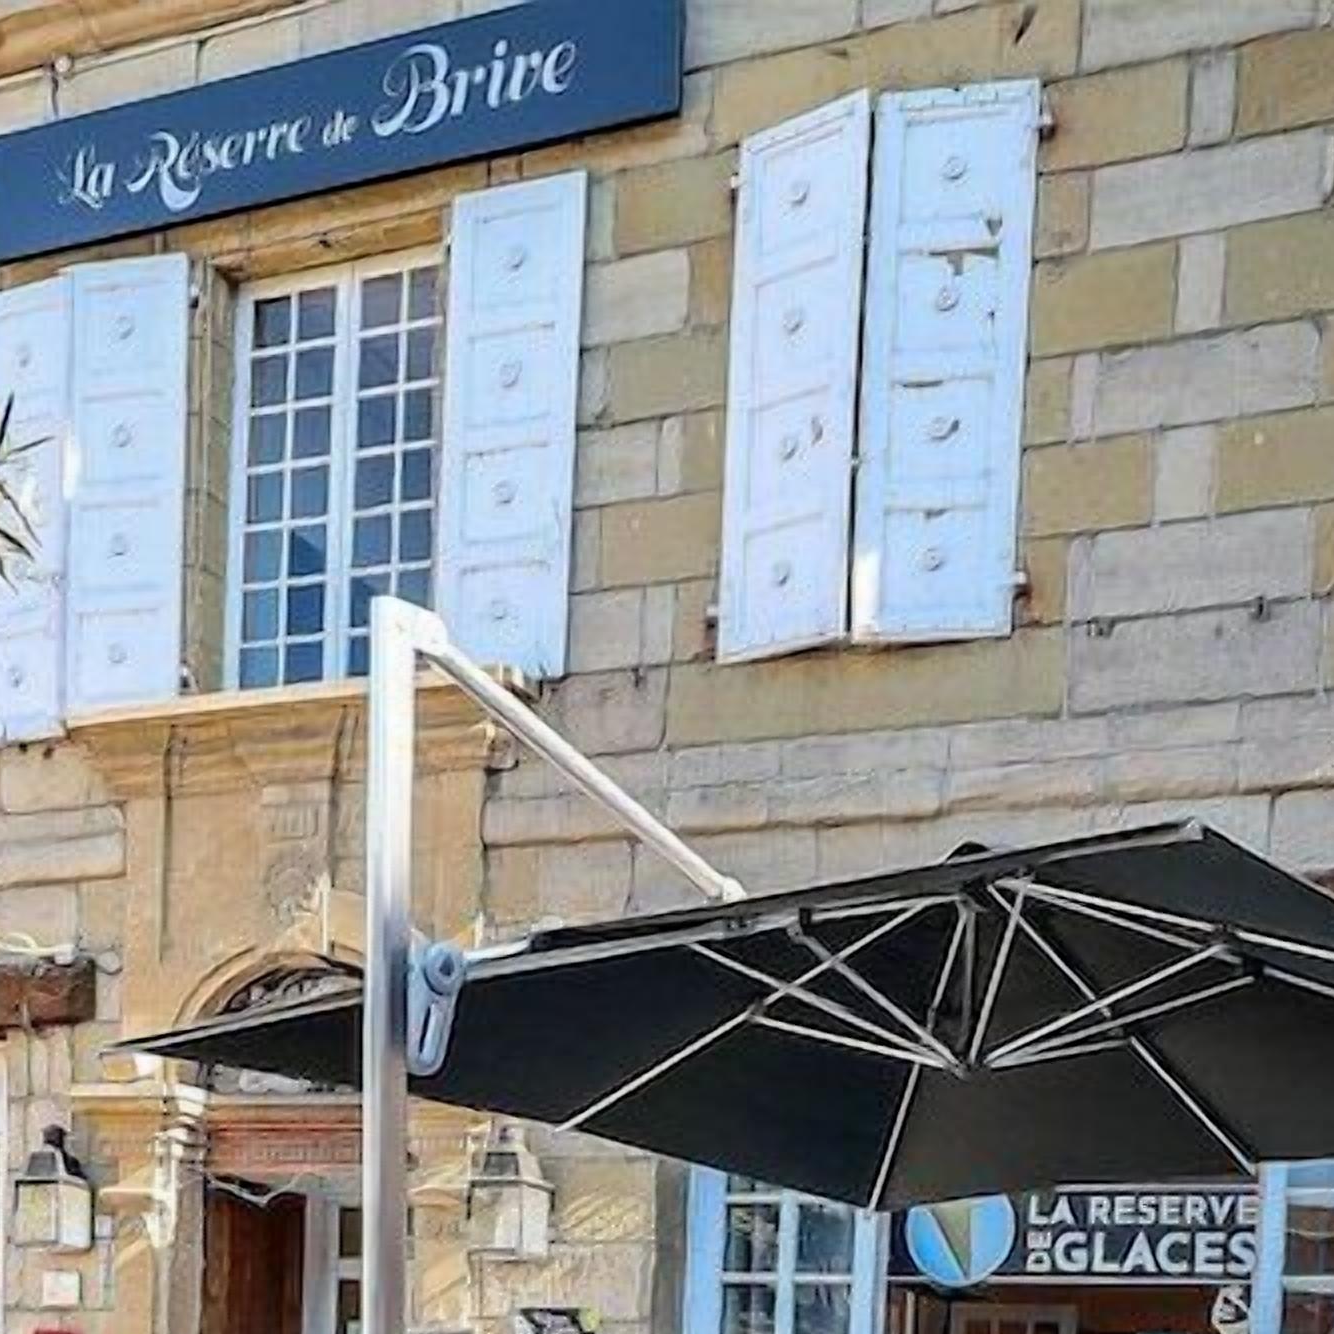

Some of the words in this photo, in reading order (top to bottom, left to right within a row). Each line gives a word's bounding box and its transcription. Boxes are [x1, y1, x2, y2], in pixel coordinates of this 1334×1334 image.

[57, 145, 116, 210] La
[322, 110, 357, 147] de
[370, 39, 576, 137] Brive
[1028, 1194, 1076, 1225] LA
[1088, 1195, 1259, 1226] RESERVE
[1025, 1230, 1053, 1272] DE
[1053, 1231, 1257, 1276] GLACES
